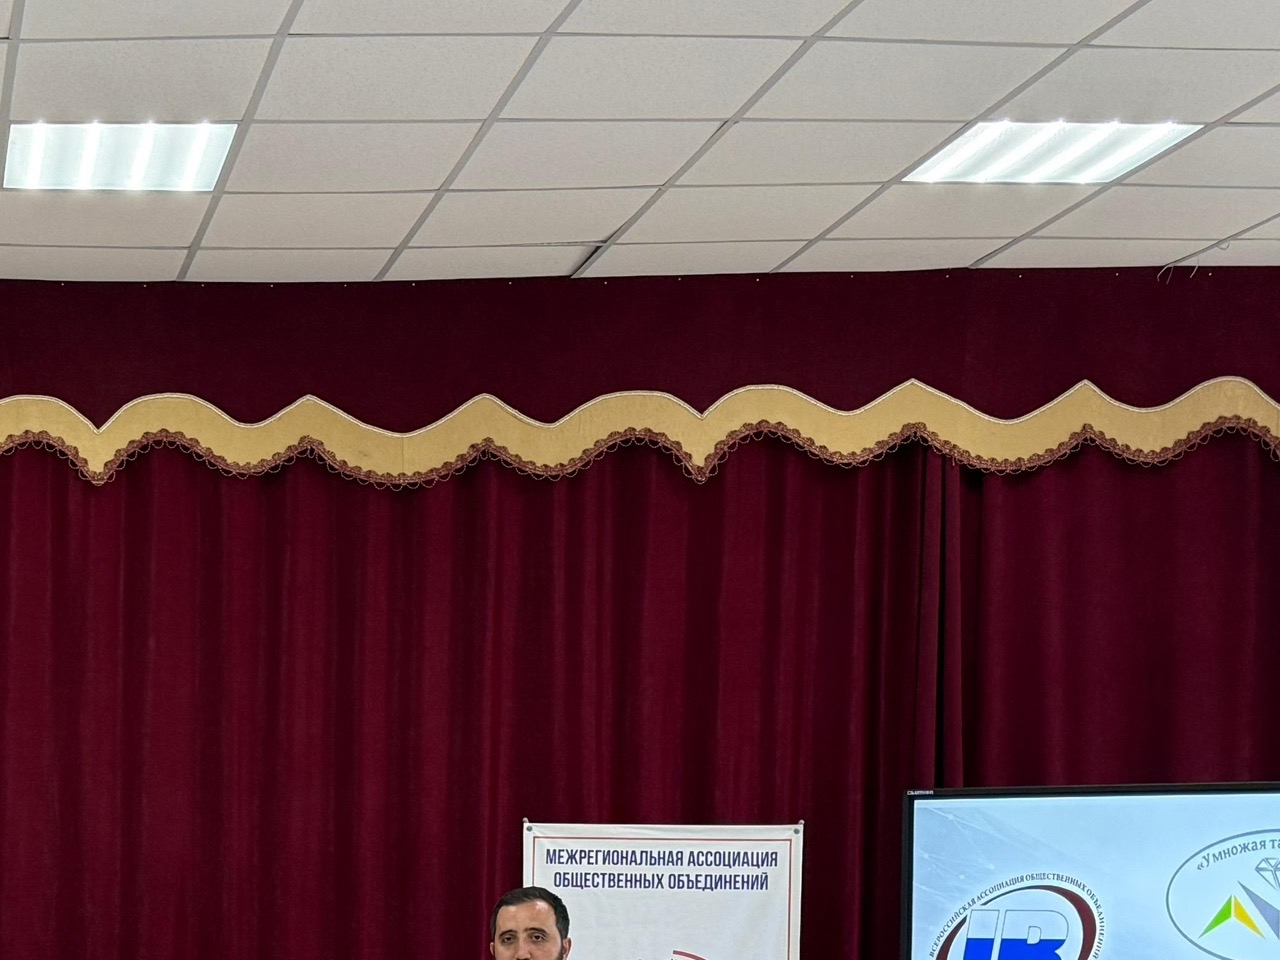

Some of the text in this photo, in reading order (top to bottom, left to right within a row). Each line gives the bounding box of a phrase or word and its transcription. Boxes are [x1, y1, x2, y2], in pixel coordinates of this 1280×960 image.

[545, 848, 778, 869] МЕЖРЕГИОНАЛЬНАЯ АССОЦИАЦИЯ
[1196, 840, 1267, 871] «Умножая
[553, 871, 769, 892] ОБЩЕСТВЕННЫХ ОБЪЕДИНЕНИЙ
[975, 875, 1025, 903] АССОЦИАЦИЯ
[1025, 872, 1087, 892] ОБЩЕСТВЕННЫХ
